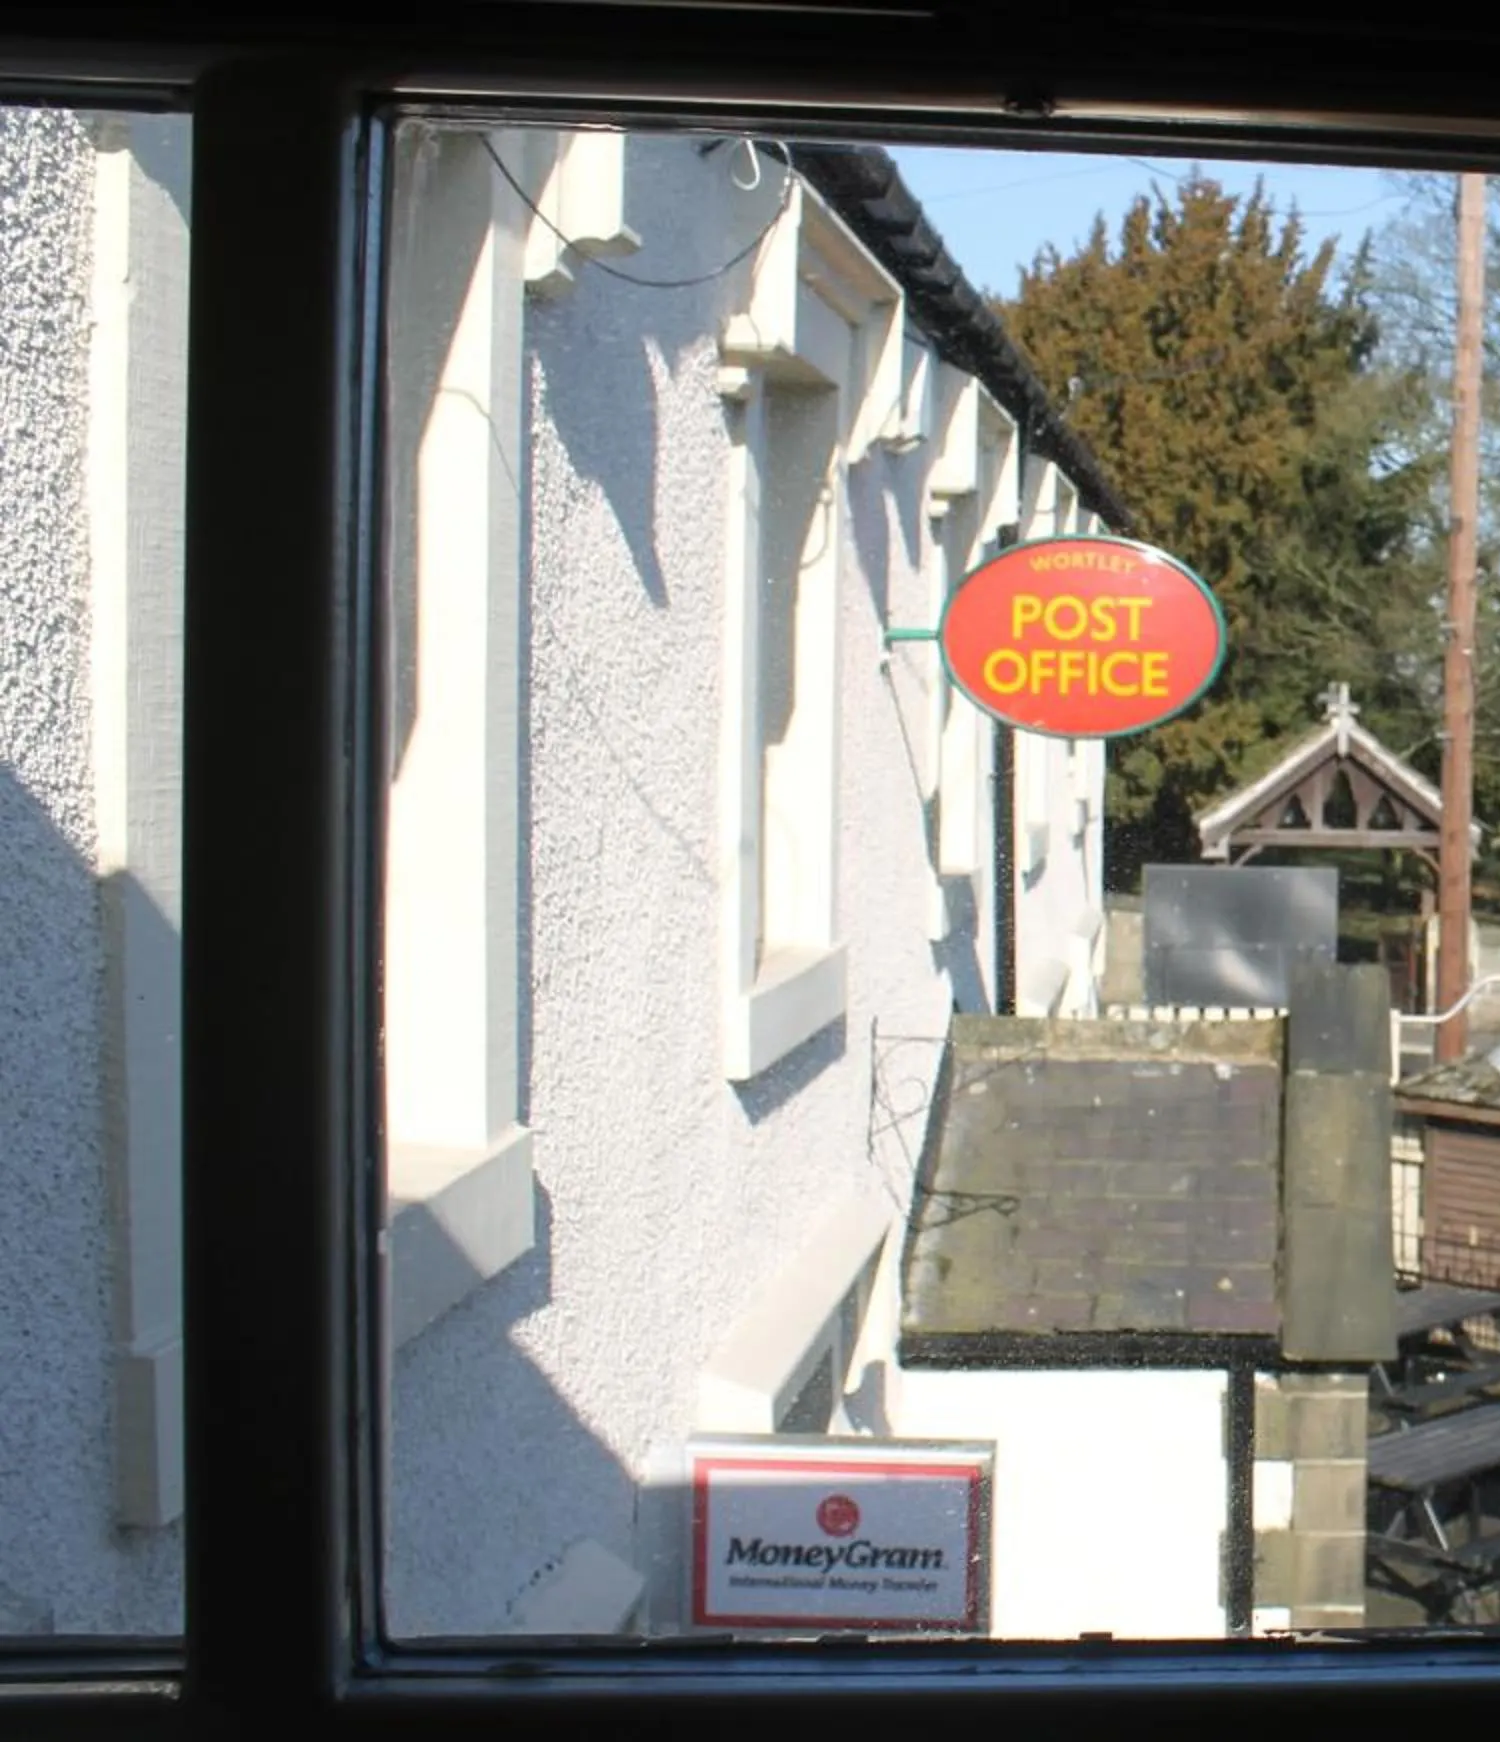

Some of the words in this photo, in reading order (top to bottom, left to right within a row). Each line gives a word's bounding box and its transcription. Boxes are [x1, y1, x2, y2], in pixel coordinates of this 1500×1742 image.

[1029, 551, 1138, 573] WORTLEY
[1012, 595, 1153, 641] POST
[983, 648, 1170, 696] OFFICE
[726, 1537, 943, 1574] MoneyGram
